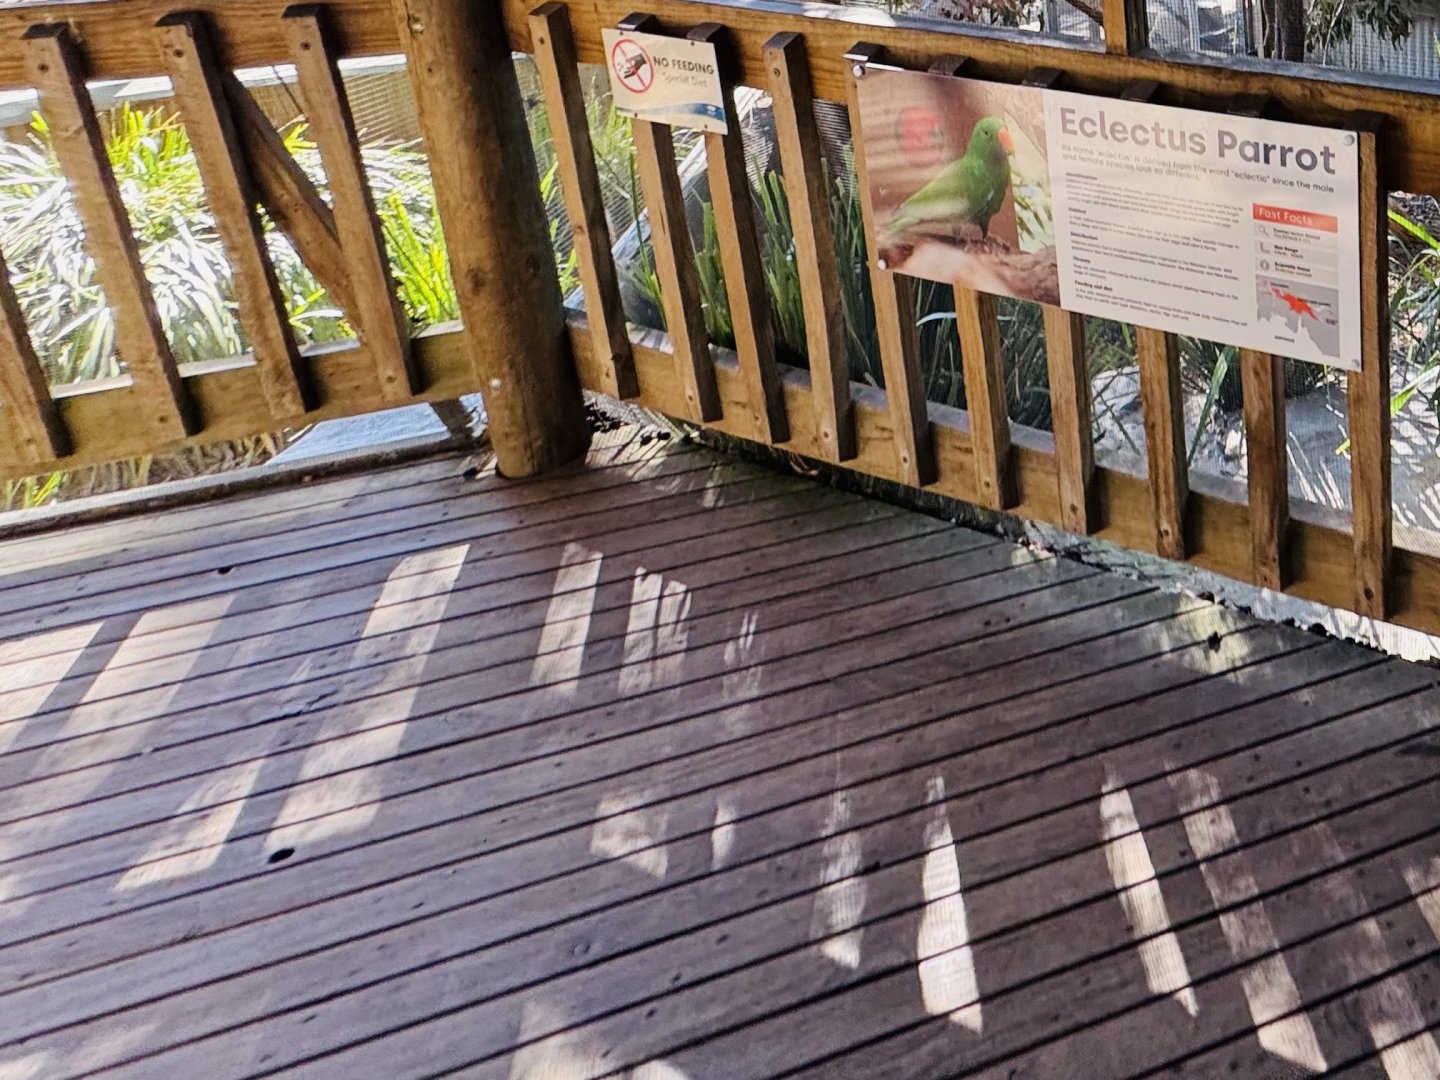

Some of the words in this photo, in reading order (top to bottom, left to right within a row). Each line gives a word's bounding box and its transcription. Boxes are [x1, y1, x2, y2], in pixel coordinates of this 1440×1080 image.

[653, 55, 669, 68] NO
[672, 58, 715, 75] FEEDING
[1060, 107, 1207, 156] Eclectus
[1217, 129, 1336, 176] Parrot
[1062, 153, 1078, 162] and
[1078, 154, 1104, 167] female
[1106, 158, 1135, 172] species
[1154, 166, 1164, 175] so
[1173, 159, 1192, 171] from
[1193, 163, 1208, 174] the
[1208, 167, 1231, 177] word
[1272, 175, 1295, 188] since
[1296, 178, 1311, 190] the
[1313, 182, 1335, 194] male
[1259, 207, 1281, 221] Fast
[1284, 212, 1314, 226] Facts
